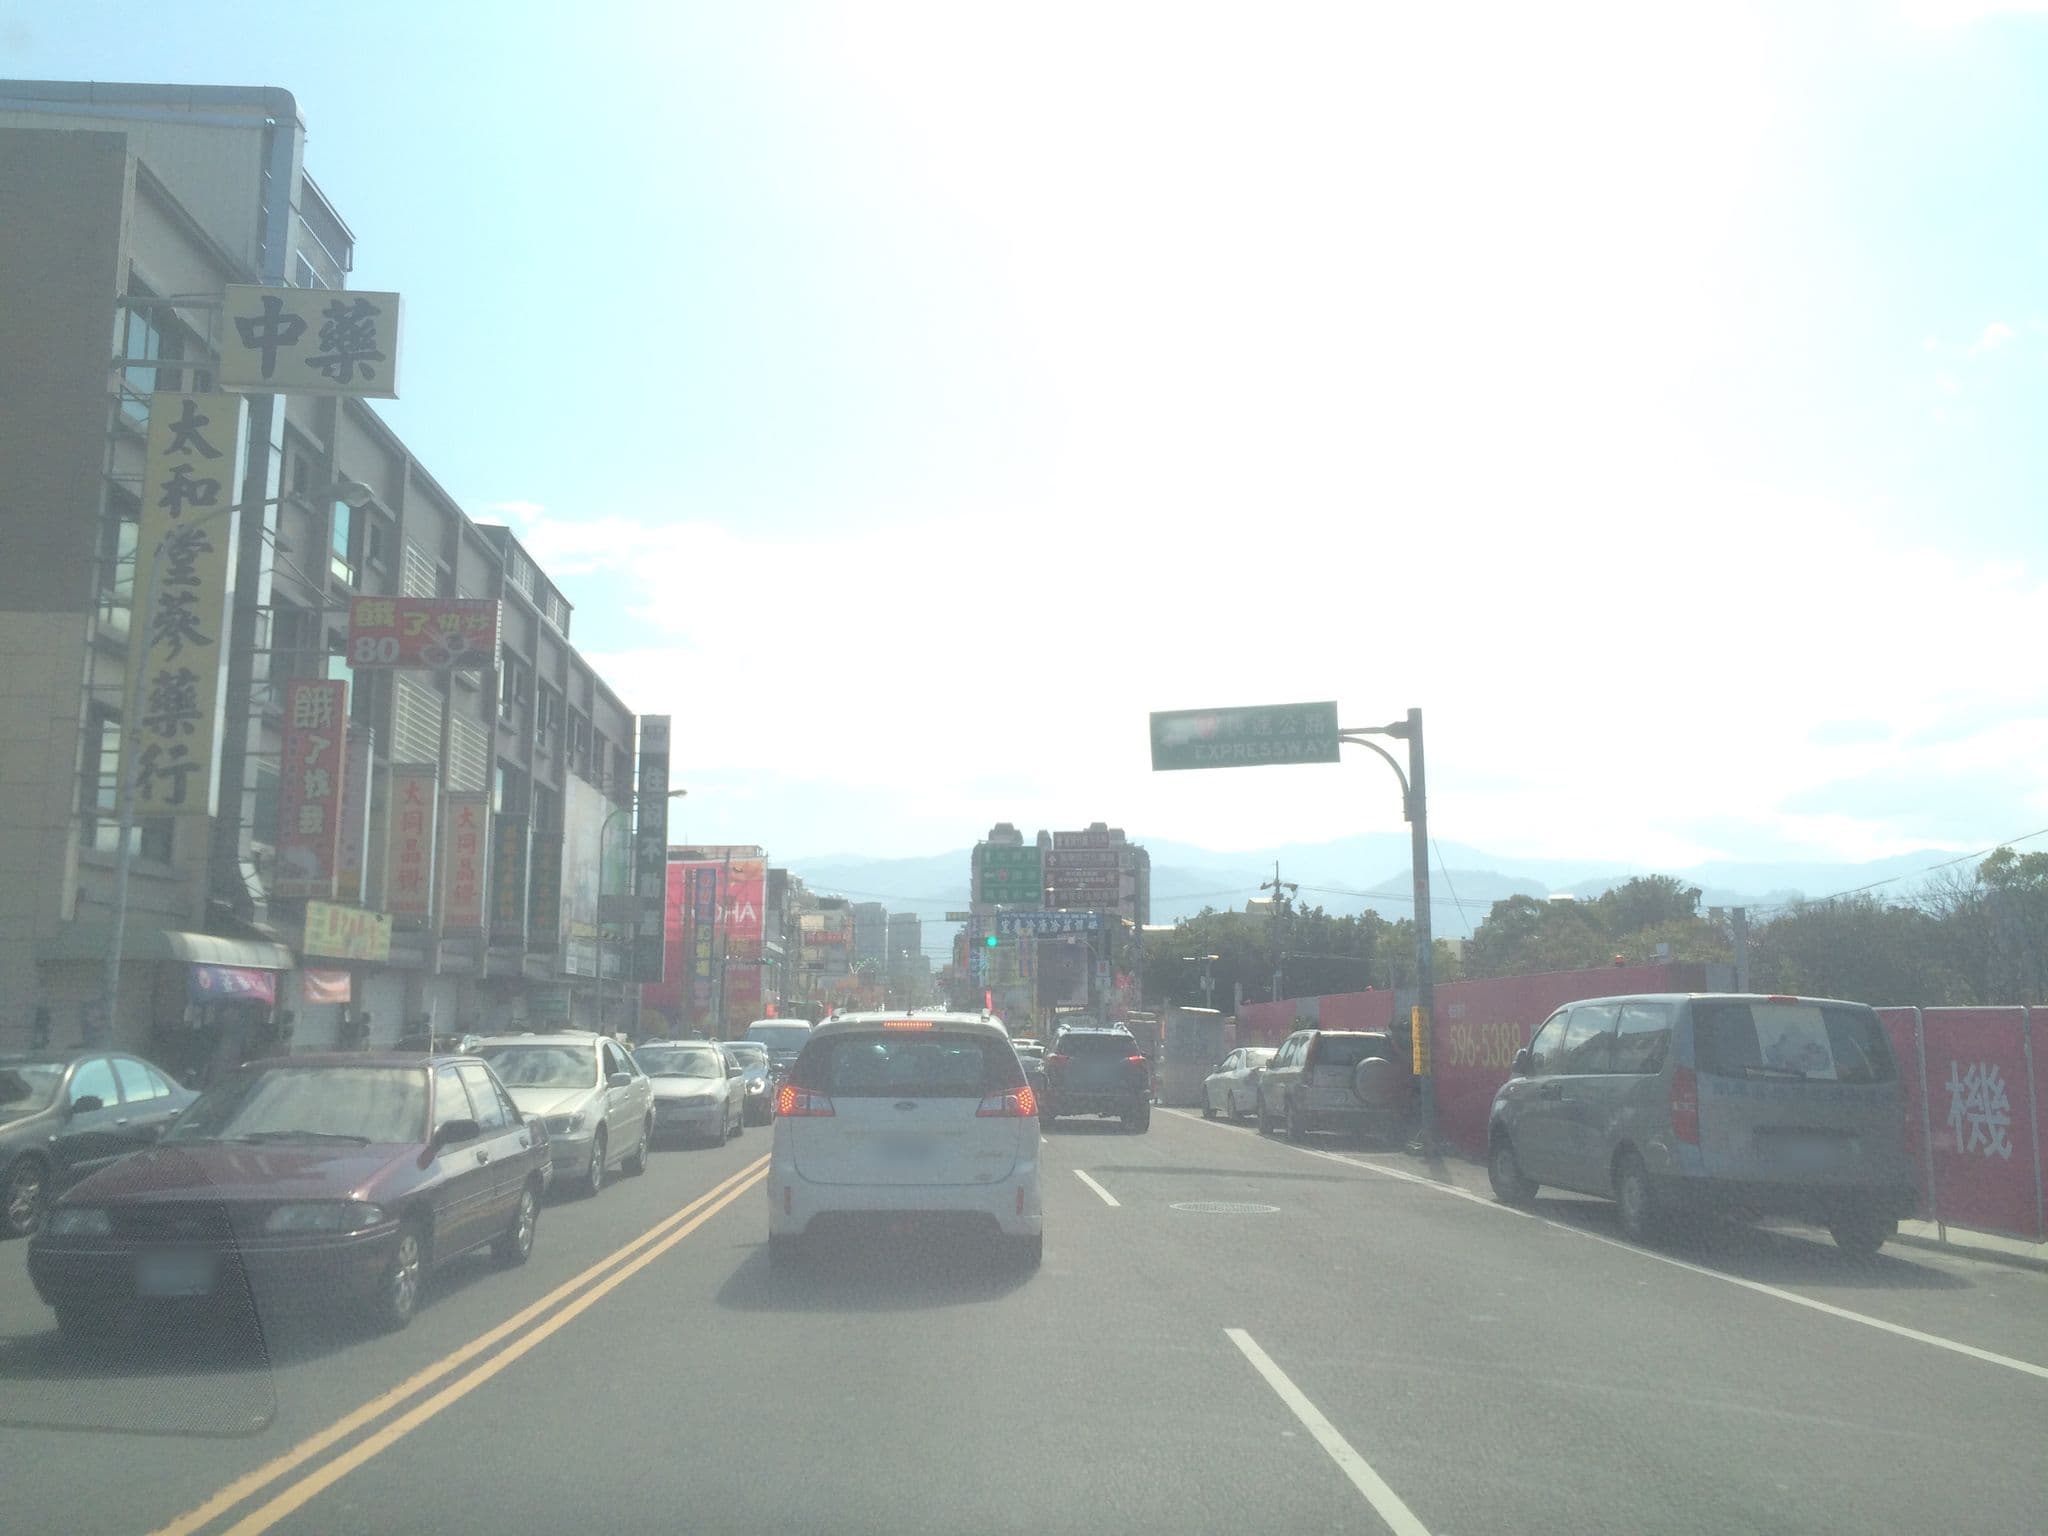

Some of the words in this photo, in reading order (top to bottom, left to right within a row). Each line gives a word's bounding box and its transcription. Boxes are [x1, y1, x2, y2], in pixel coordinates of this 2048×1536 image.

[235, 294, 385, 384] 中藥
[353, 636, 400, 664] 80
[1194, 741, 1331, 761] EXPRESSWAY
[1945, 1060, 2013, 1160] 機
